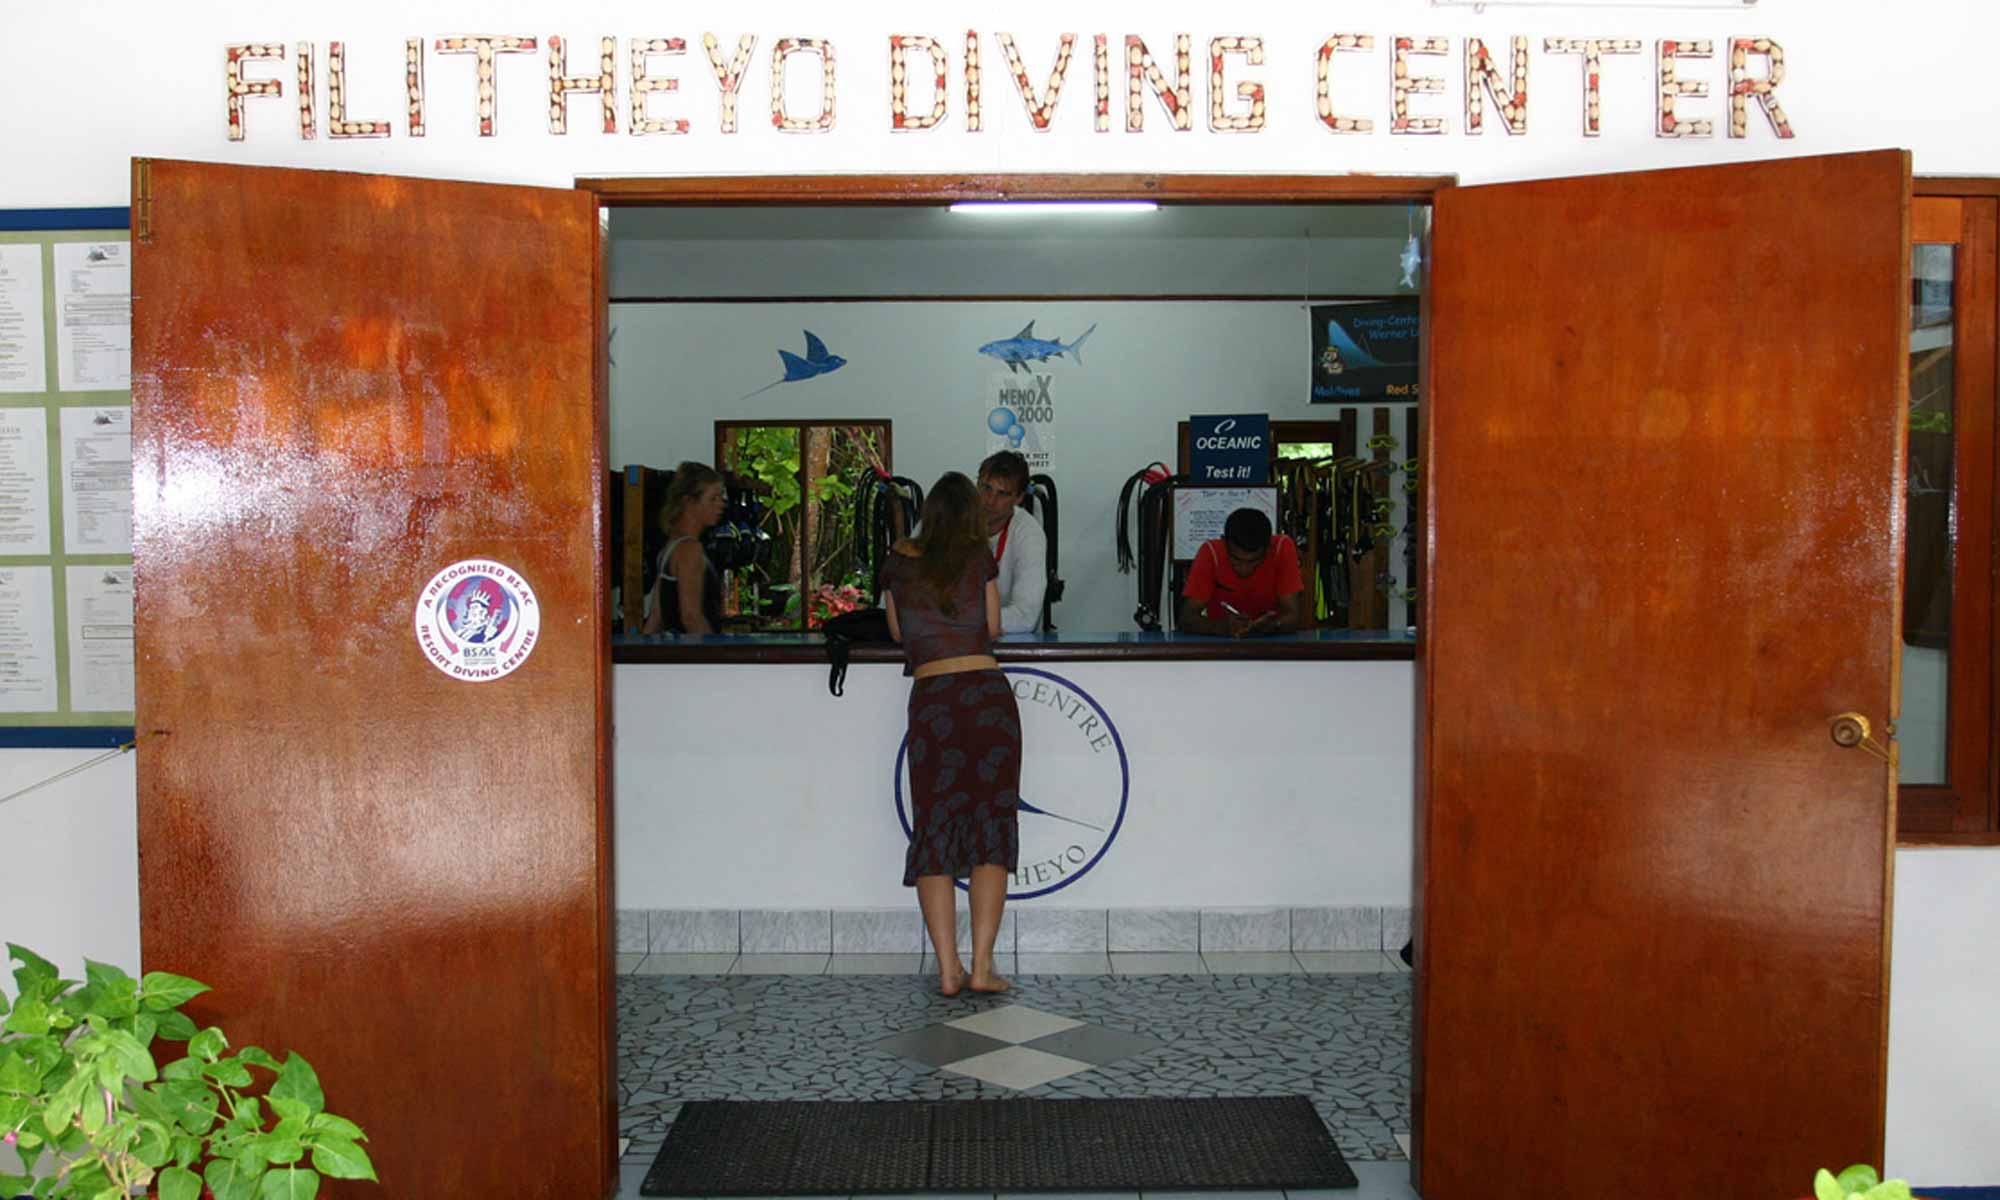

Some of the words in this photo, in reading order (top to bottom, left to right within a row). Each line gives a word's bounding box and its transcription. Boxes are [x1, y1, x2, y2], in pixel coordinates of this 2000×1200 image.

[224, 34, 837, 141] FILITHEYO
[888, 29, 1265, 133] DIVING
[1314, 33, 1795, 138] CENTER
[1386, 384, 1408, 395] Red
[1018, 407, 1053, 423] 2000
[1196, 436, 1262, 449] OCEANIC
[1205, 466, 1234, 478] Test
[1237, 466, 1251, 478] it!
[423, 599, 432, 609] A
[430, 564, 505, 597] RECOGNISED
[420, 625, 451, 669] RESORT
[453, 665, 499, 678] DIVING
[502, 630, 535, 670] CENTRE
[463, 647, 497, 658] BSAC
[1013, 678, 1112, 754] CENTRE
